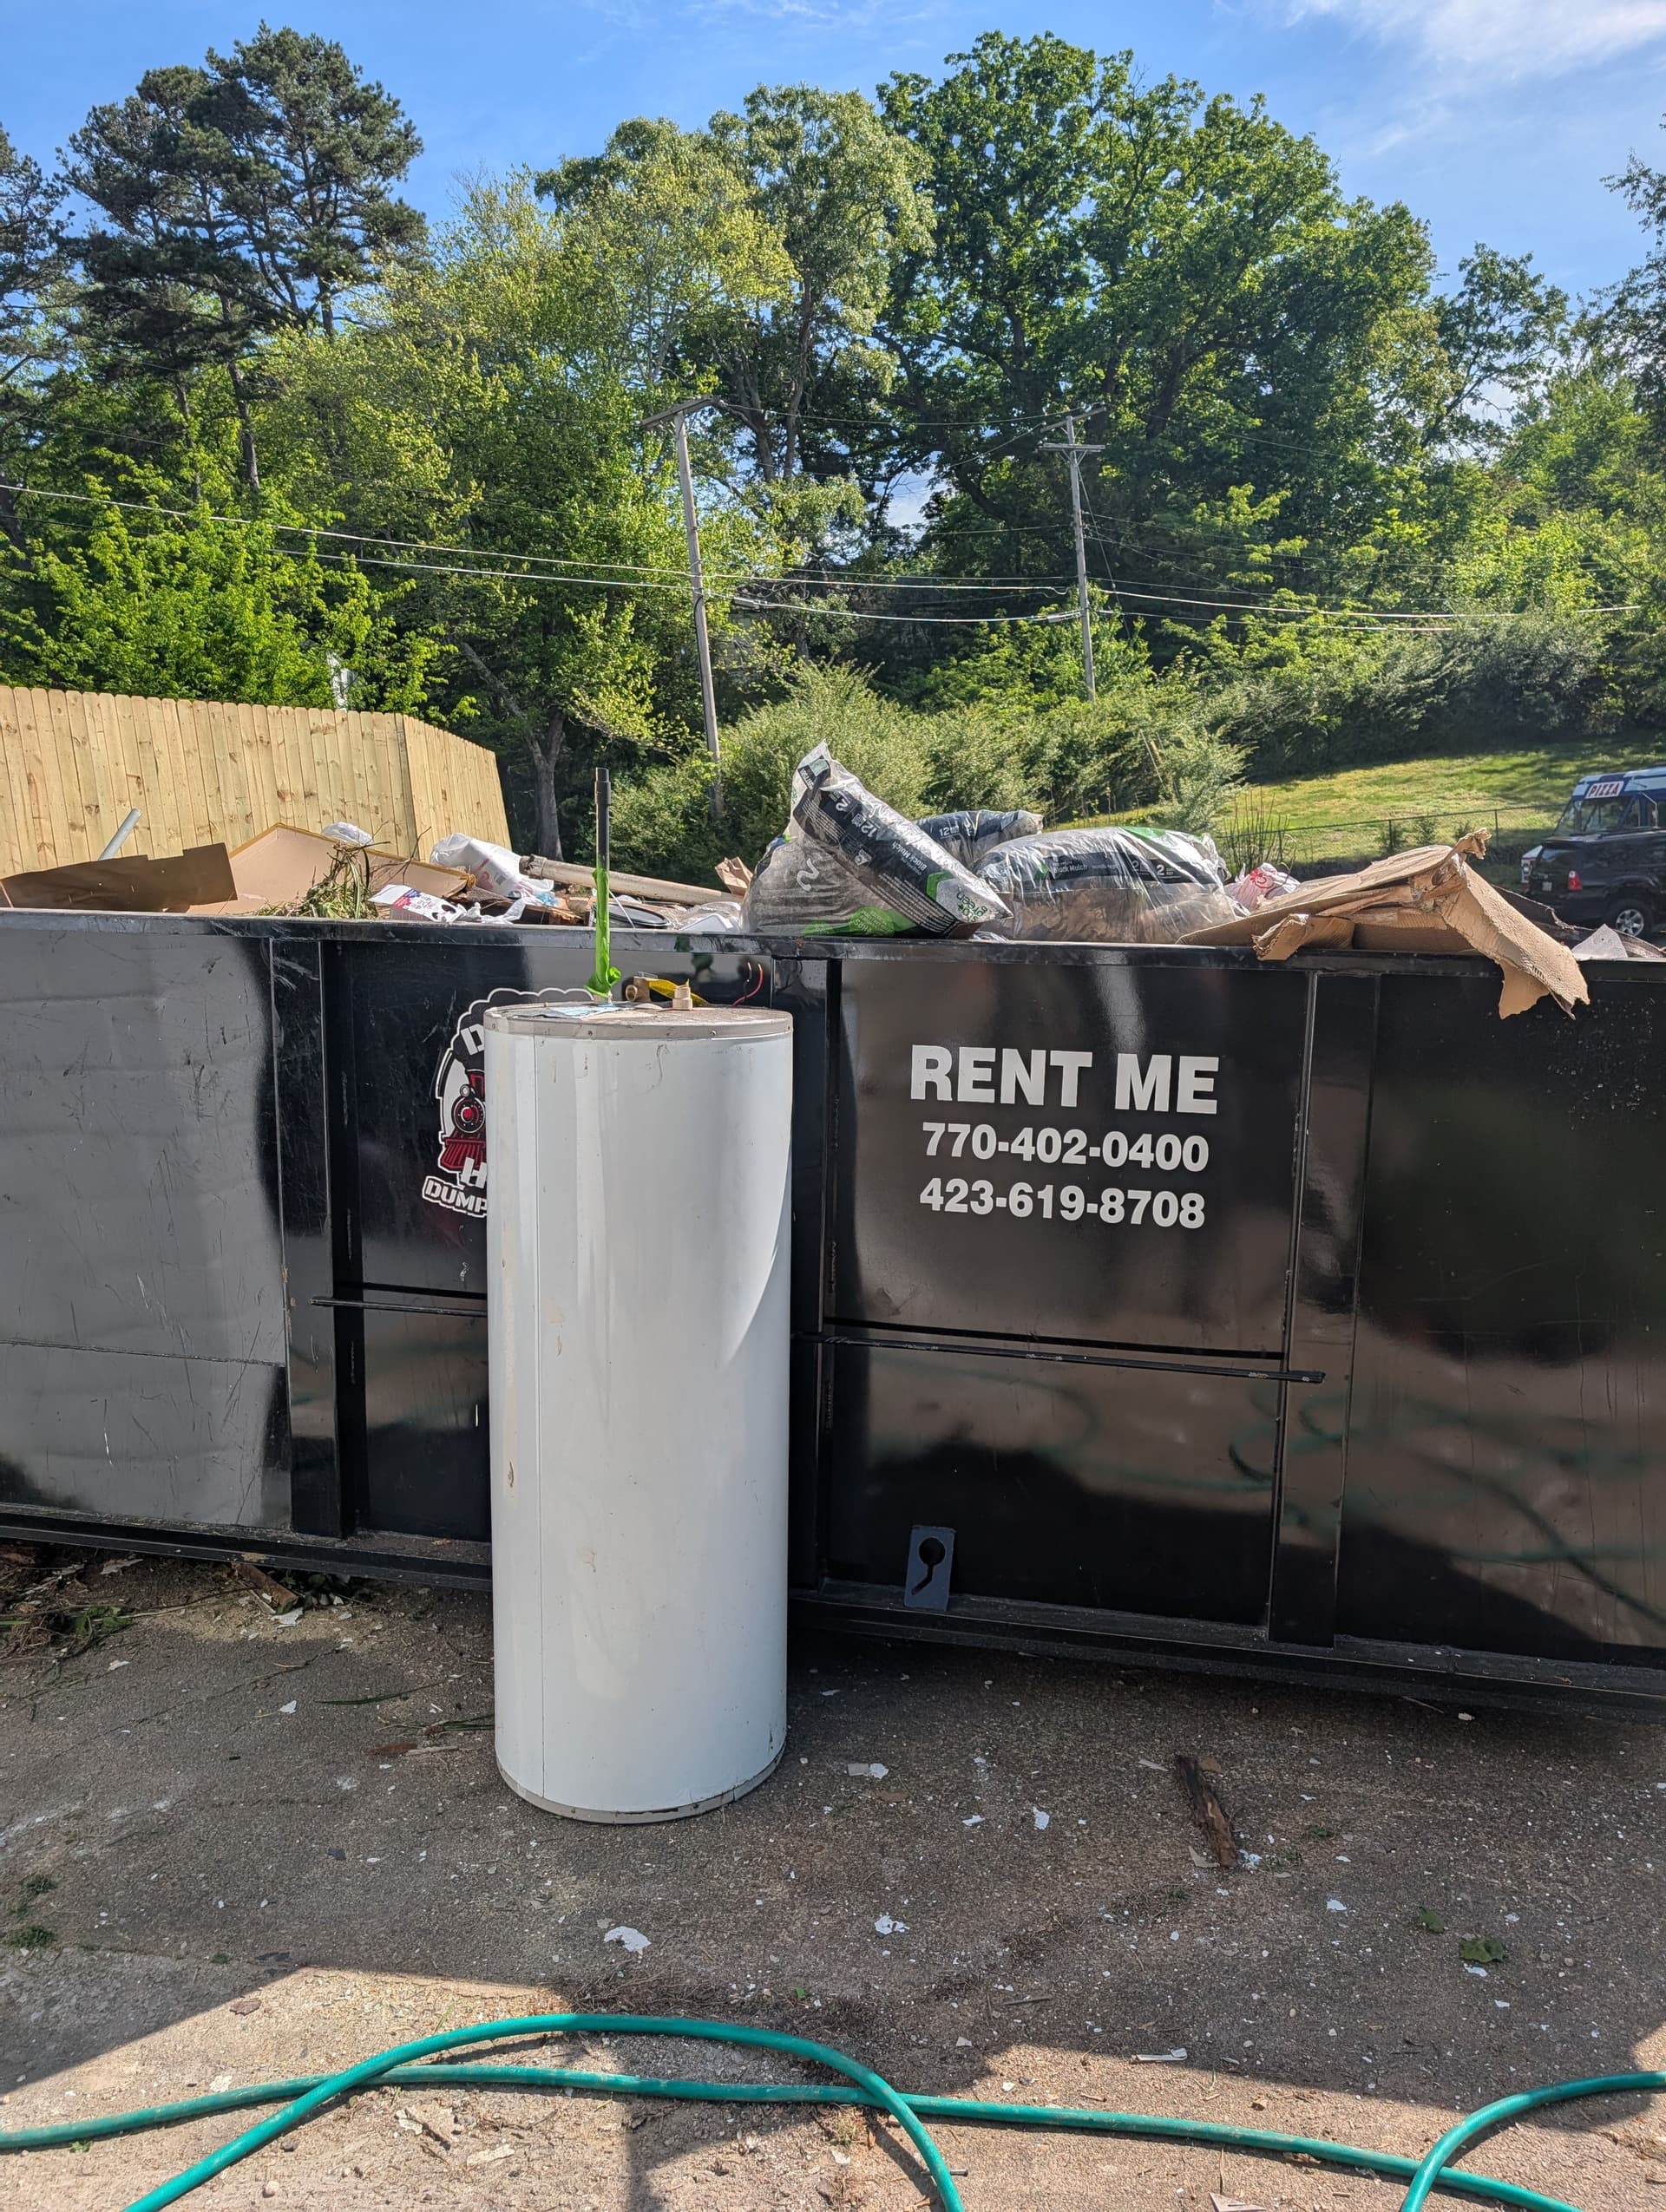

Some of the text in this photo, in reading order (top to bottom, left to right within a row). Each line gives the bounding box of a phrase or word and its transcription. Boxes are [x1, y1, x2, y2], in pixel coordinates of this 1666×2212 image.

[1588, 782, 1620, 797] PIZZA
[861, 821, 877, 837] 12
[939, 827, 950, 836] 12
[892, 841, 911, 859] Mulch
[1156, 864, 1165, 875] 2
[956, 891, 988, 917] green
[910, 1044, 1220, 1115] RENT ME
[922, 1122, 1209, 1172] 770-402-0400
[920, 1177, 1205, 1228] 423-619-8708
